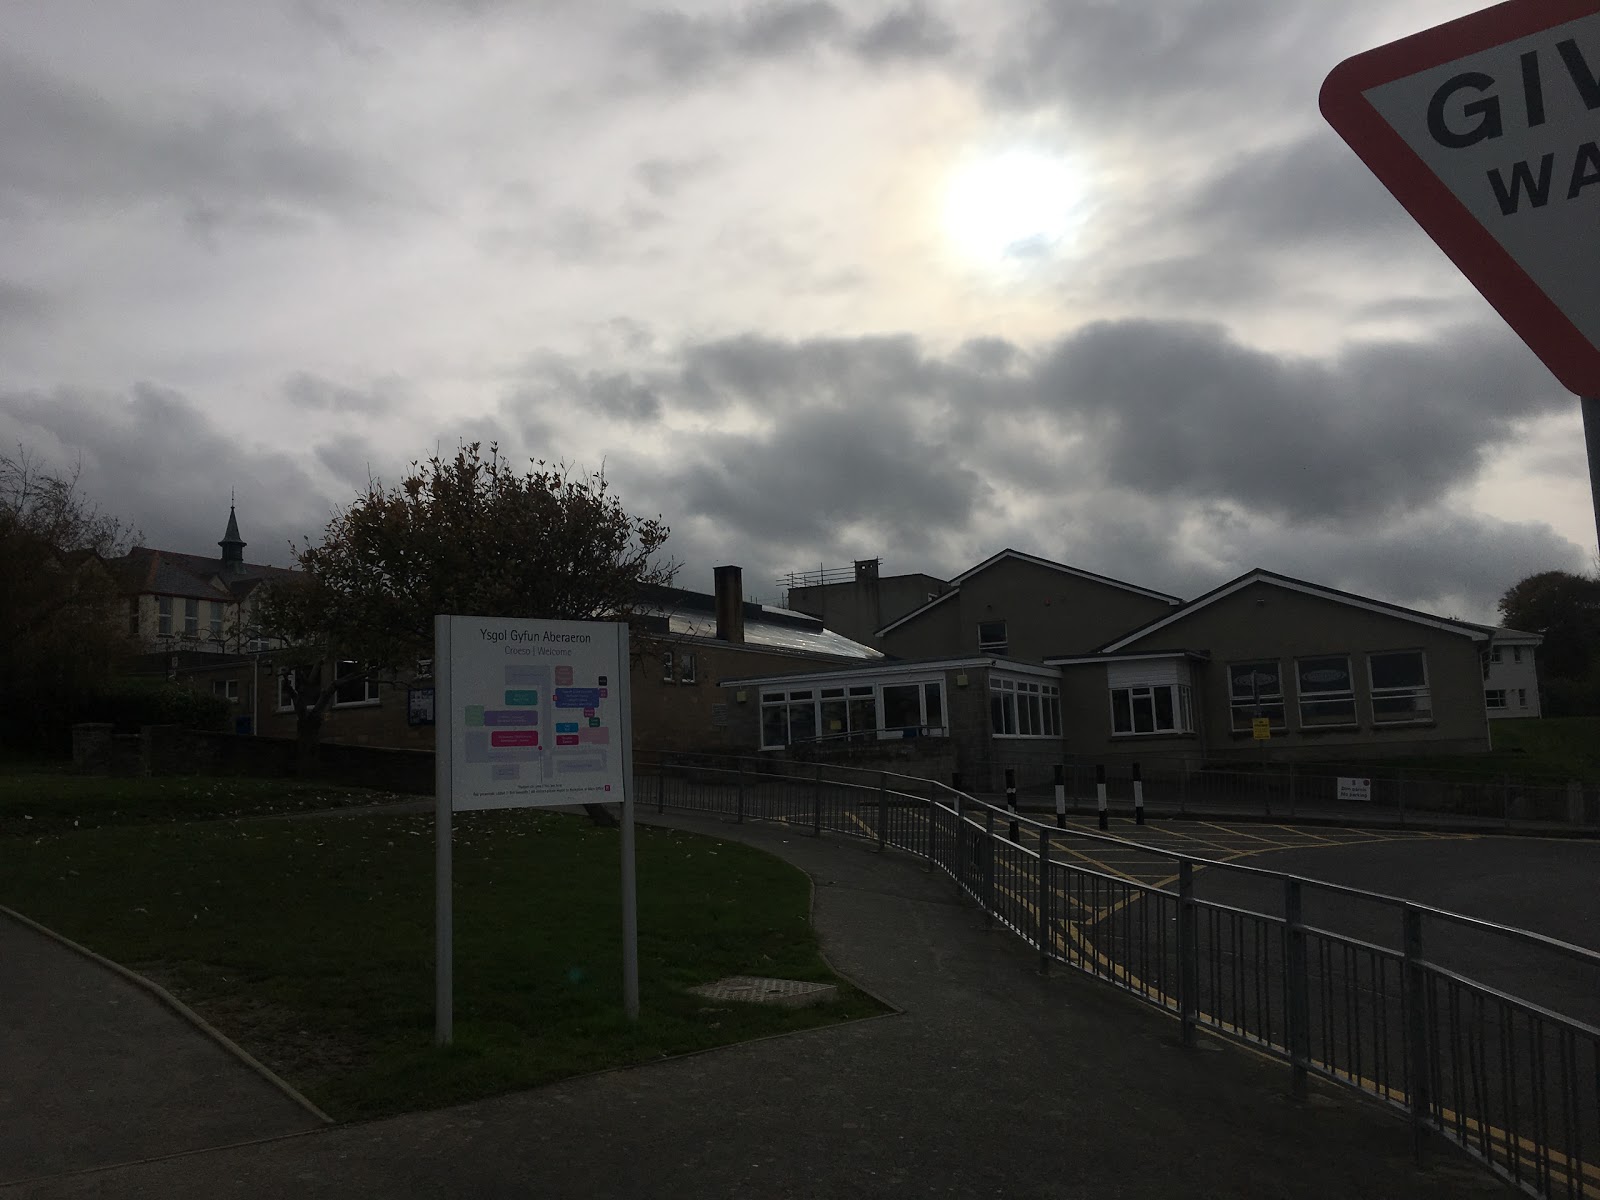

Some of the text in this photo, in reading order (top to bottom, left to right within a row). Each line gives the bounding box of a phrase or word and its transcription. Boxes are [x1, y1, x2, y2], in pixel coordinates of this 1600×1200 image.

[480, 629, 591, 643] Ysgol Gyfun Aberaeron
[504, 645, 531, 655] Croeso
[537, 646, 572, 656] Welcome
